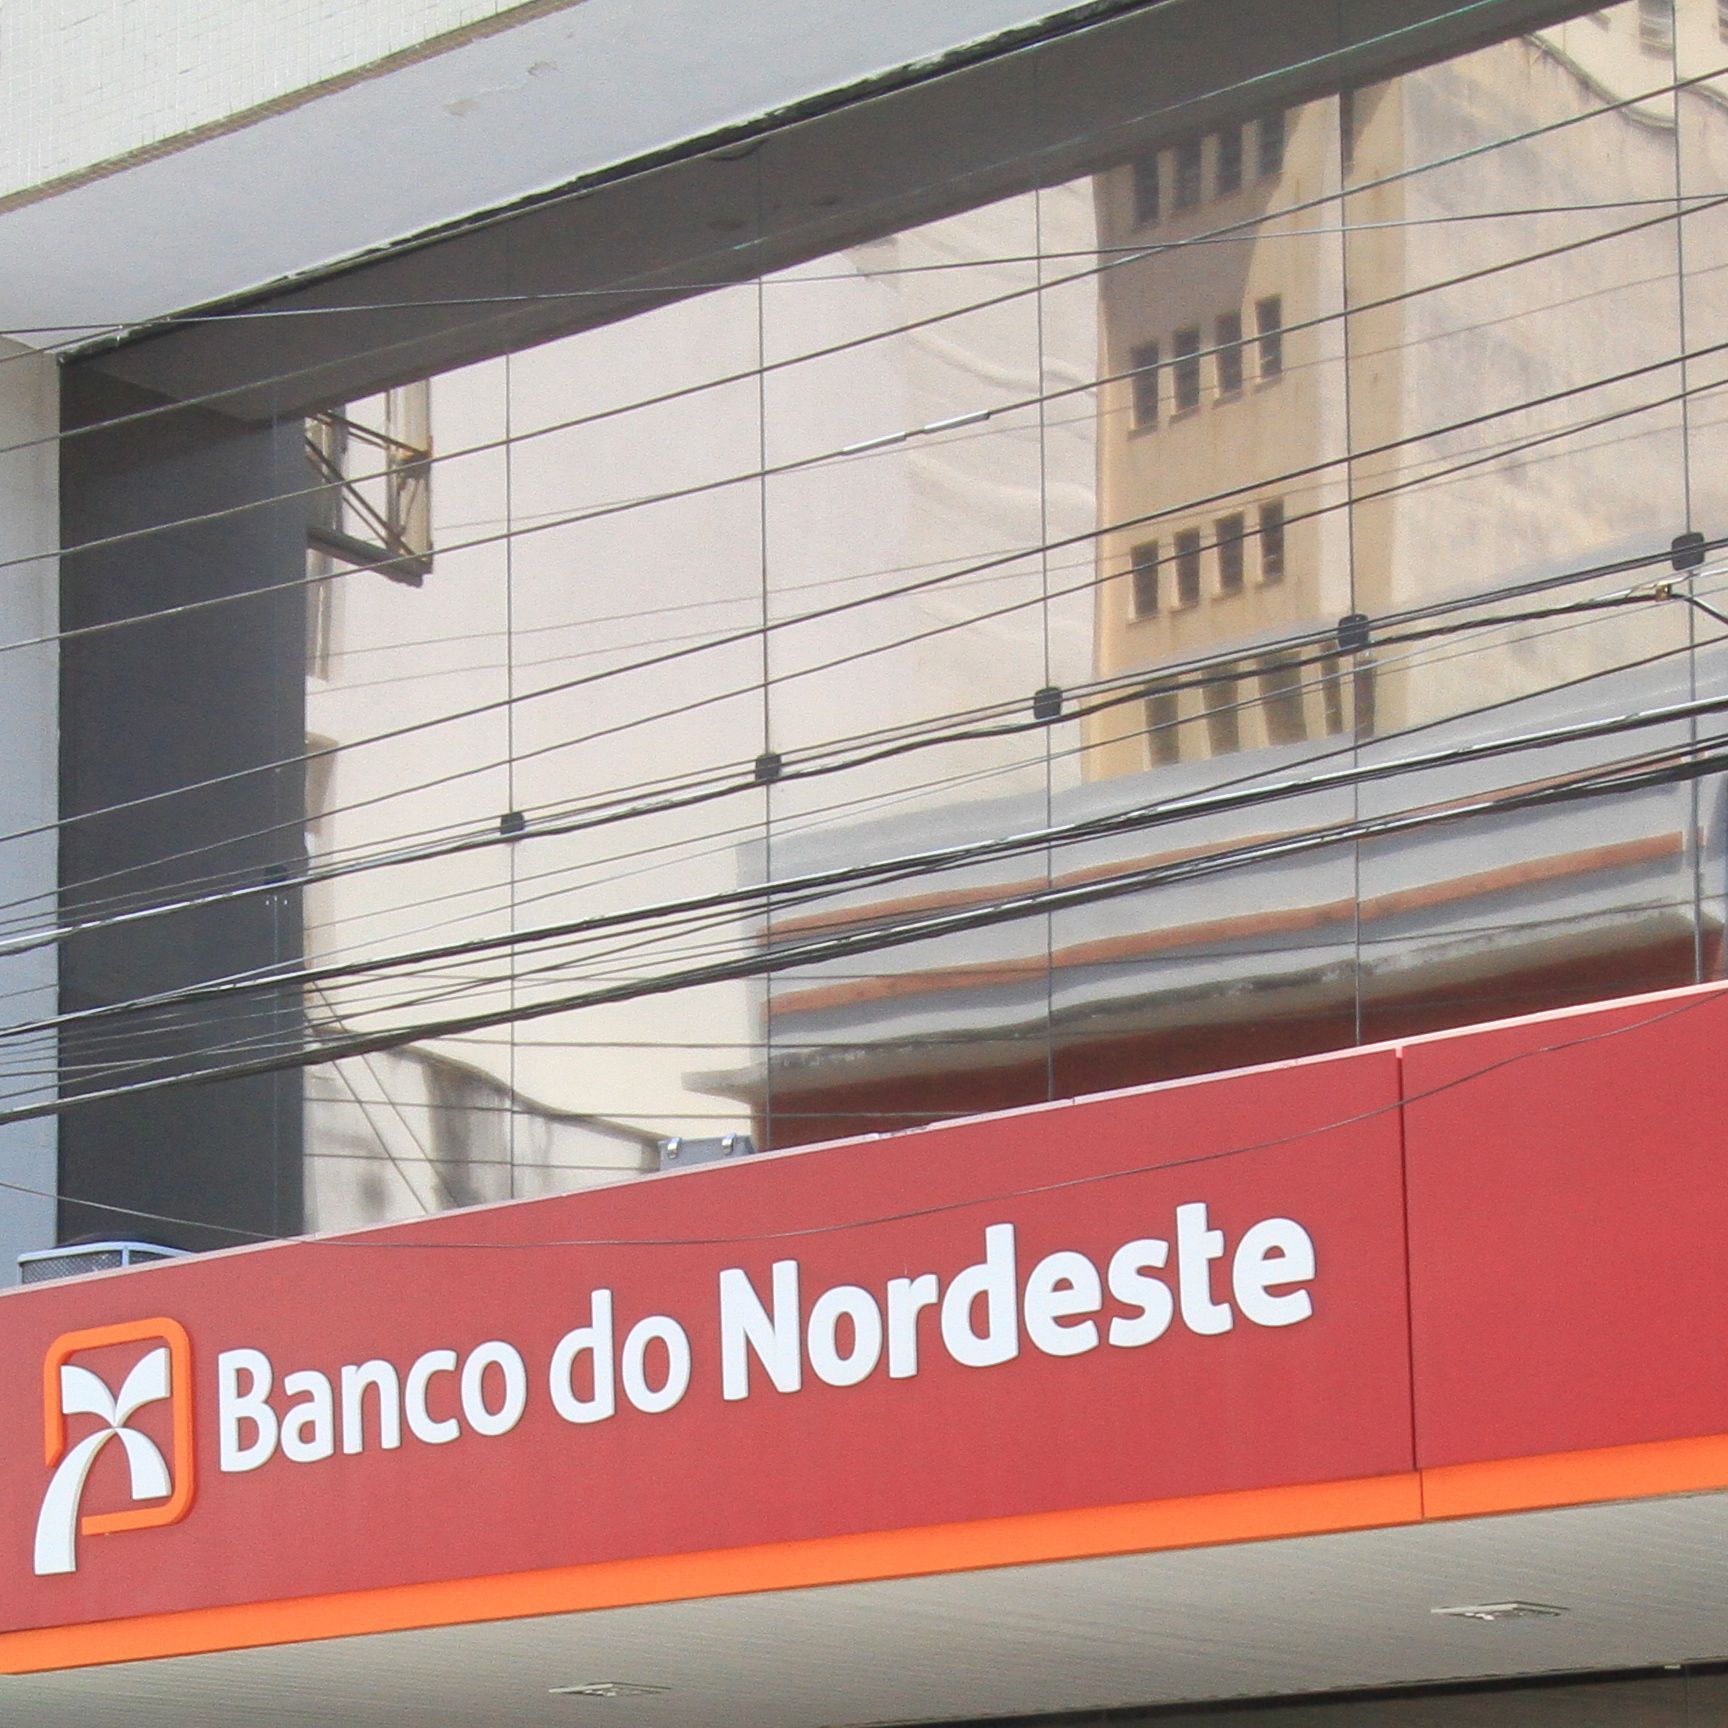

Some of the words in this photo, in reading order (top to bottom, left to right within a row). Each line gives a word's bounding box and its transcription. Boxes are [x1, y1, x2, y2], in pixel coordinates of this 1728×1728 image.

[215, 1343, 528, 1475] Banco
[548, 1287, 693, 1427] do
[719, 1201, 1317, 1403] Nordeste
